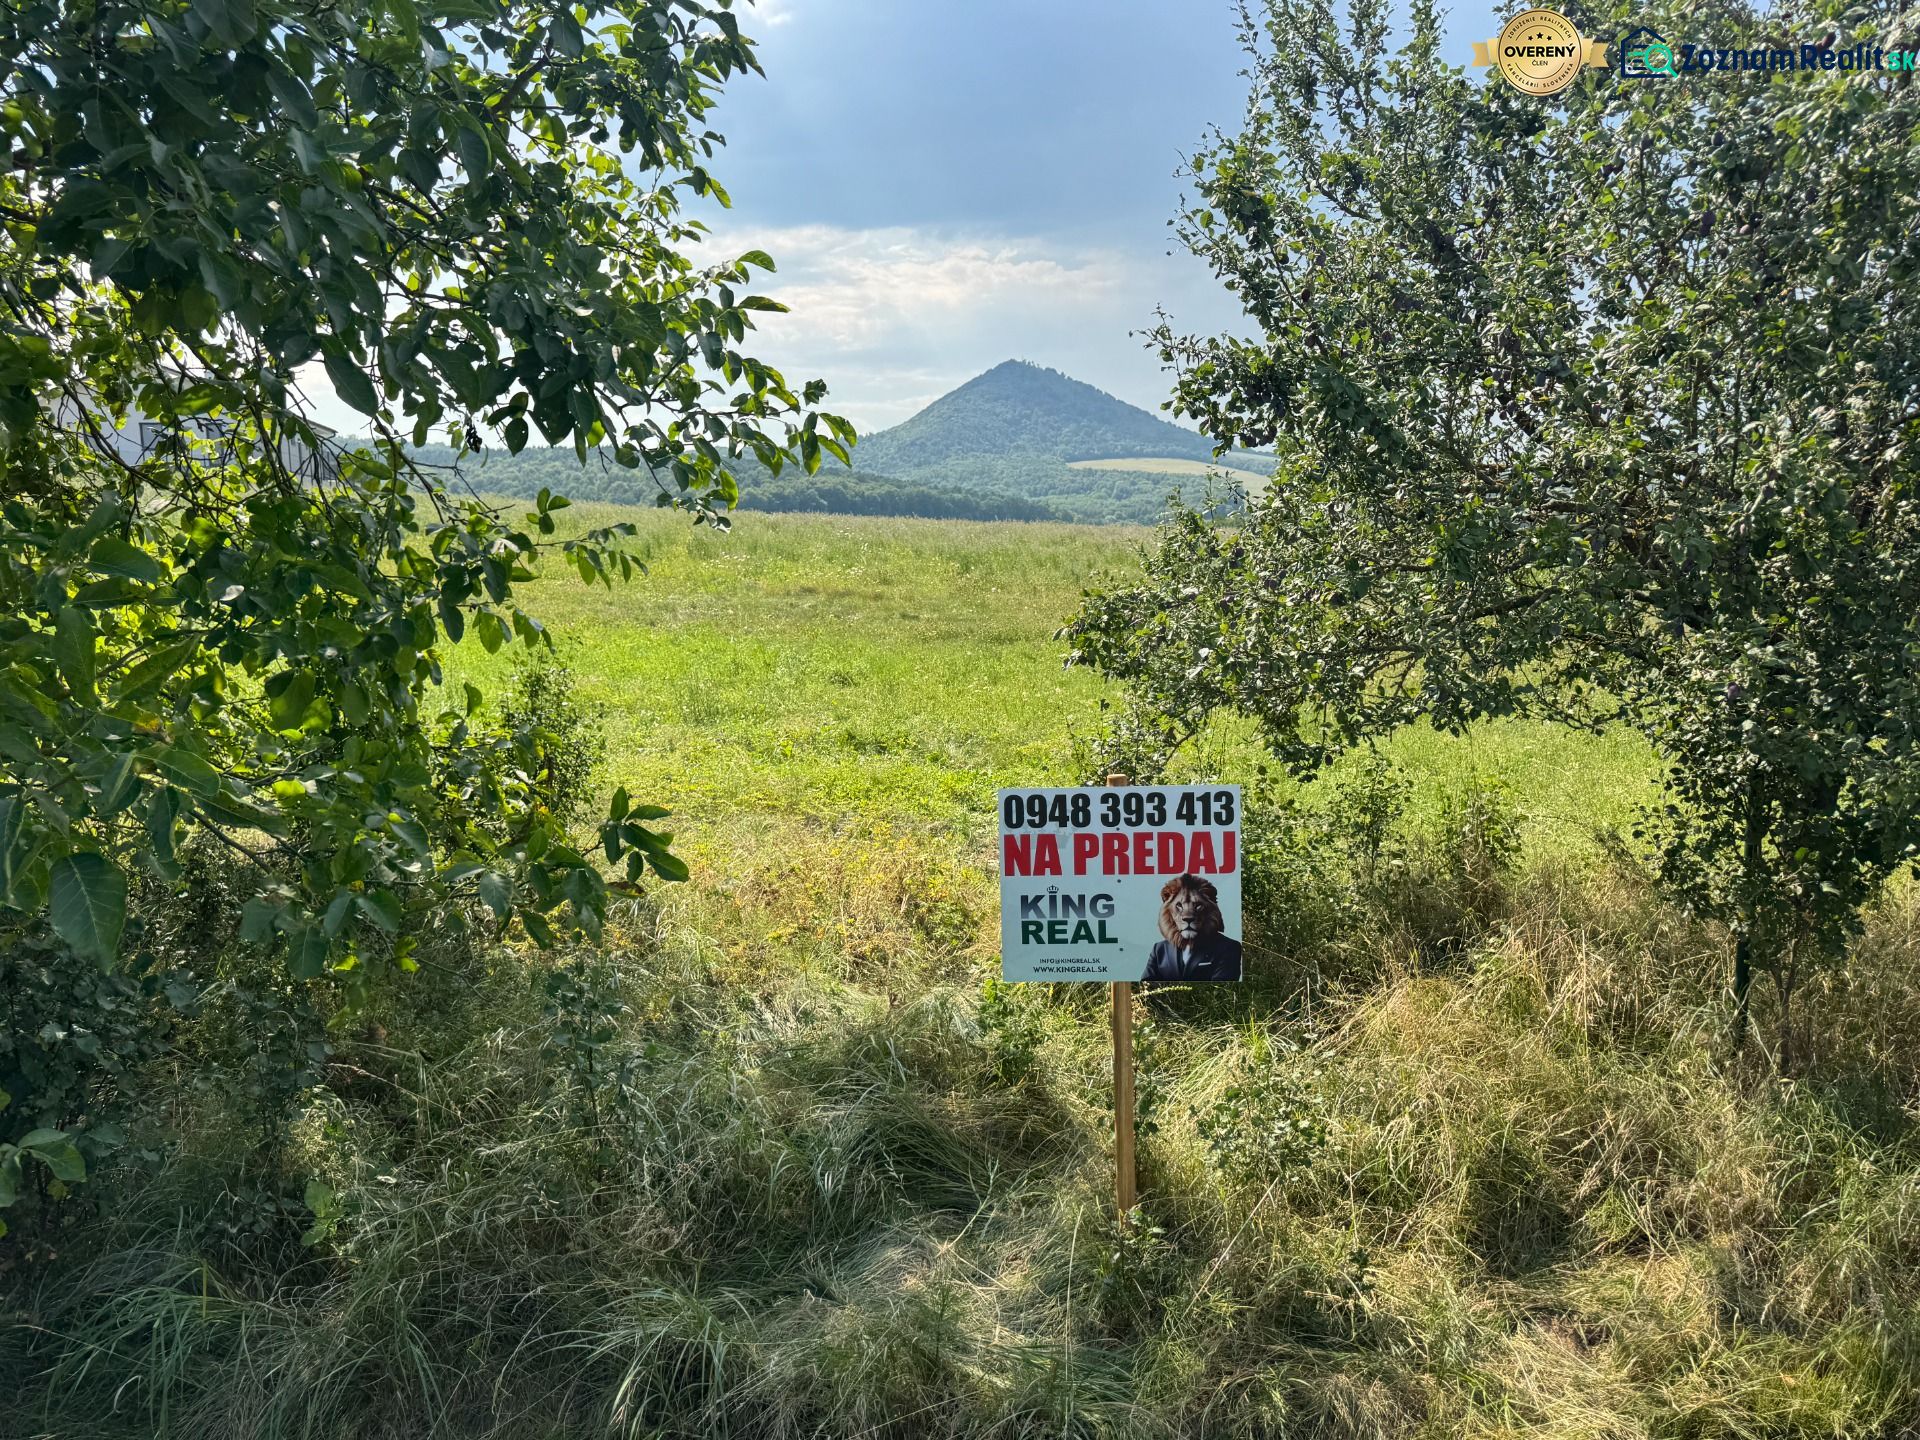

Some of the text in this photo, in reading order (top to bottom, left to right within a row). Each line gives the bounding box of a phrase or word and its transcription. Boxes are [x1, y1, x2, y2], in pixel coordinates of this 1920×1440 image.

[1004, 791, 1235, 828] 0948 393 413
[1004, 831, 1236, 876] NA PREDAJ
[1020, 889, 1115, 919] KING
[1021, 920, 1119, 944] REAL
